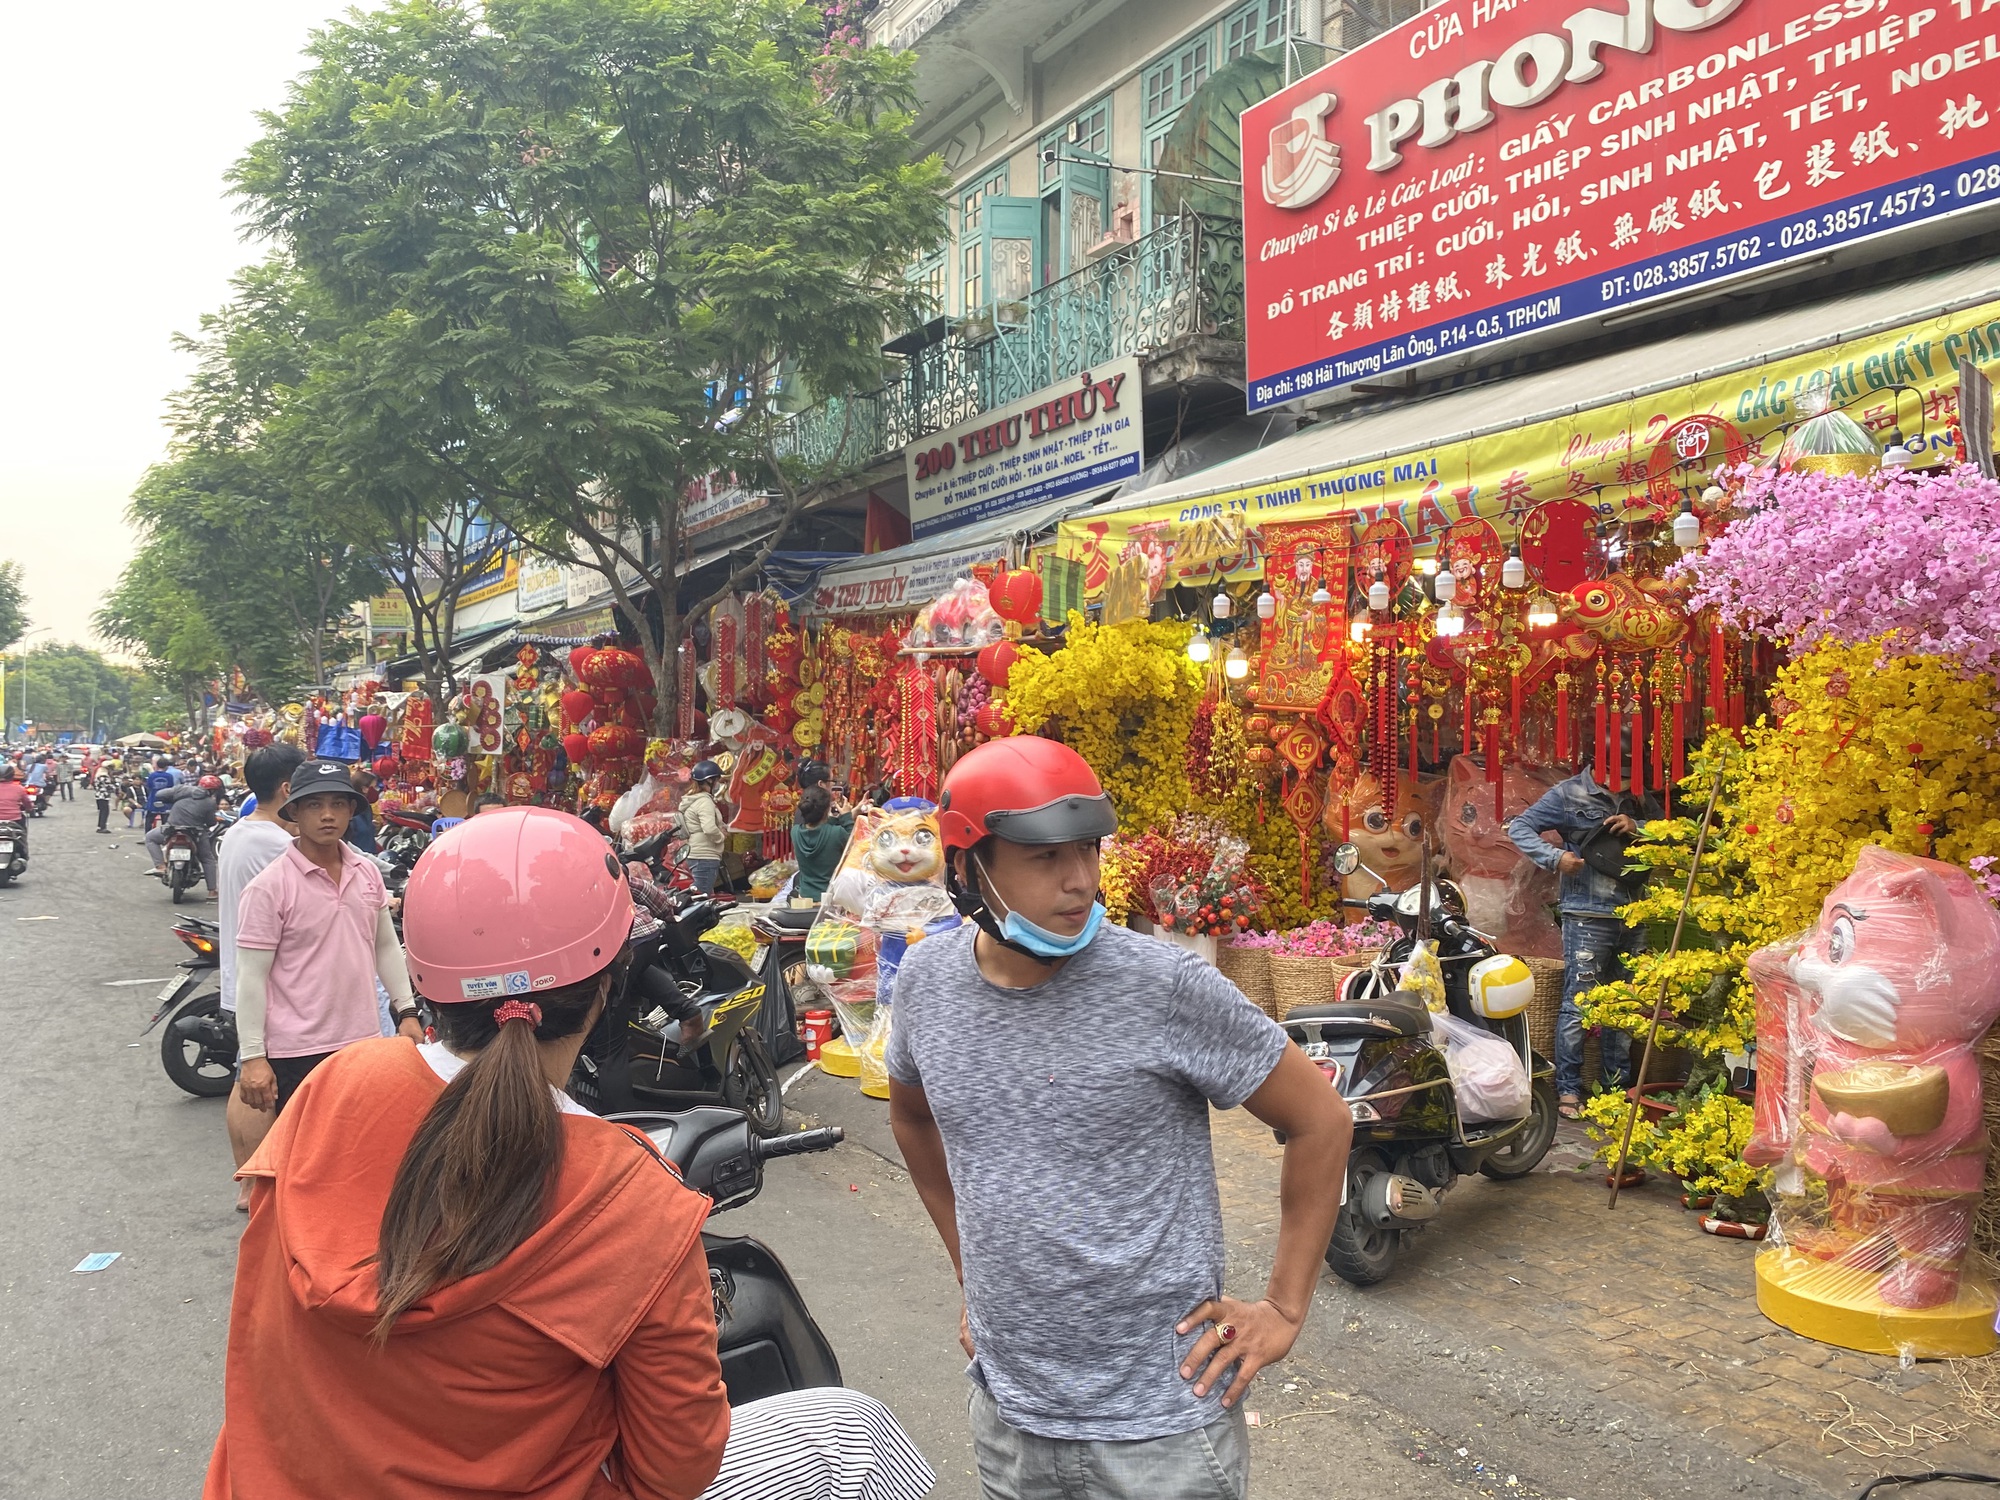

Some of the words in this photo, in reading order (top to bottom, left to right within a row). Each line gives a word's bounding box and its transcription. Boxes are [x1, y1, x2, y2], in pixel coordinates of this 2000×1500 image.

[1409, 12, 1464, 59] CỬA
[1260, 225, 1318, 262] Chuyên
[1344, 204, 1358, 226] &
[1365, 188, 1386, 218] Lẻ
[1391, 176, 1425, 208] Các
[1500, 114, 1576, 161] GIẤY
[1588, 0, 1889, 125] CARBONLESS,
[1357, 213, 1423, 251] THIỆP
[1431, 182, 1499, 221] CƯỚI,
[1505, 146, 1591, 194] THIỆP
[1600, 111, 1675, 157] SINH
[1688, 67, 1797, 125] NHẬT,
[1807, 8, 1937, 76] THIỆP
[1951, 0, 2000, 20] T
[1267, 288, 1294, 319] ĐỒ
[1299, 268, 1368, 307] TRANG
[1436, 219, 1503, 257] CƯỚI,
[1512, 195, 1570, 230] HỎI,
[1580, 166, 1653, 205] SINH
[1666, 121, 1768, 176] NHẬT,
[1784, 81, 1868, 131] TẾT,
[1892, 34, 2000, 95] NOEL
[1602, 275, 1630, 302] ĐT:
[1633, 236, 1761, 293] 028.3857.5762
[1780, 183, 1935, 250] 028.3857.4573
[1256, 385, 1272, 403] Địa
[1275, 377, 1293, 397] chỉ:
[1295, 374, 1313, 392] 198
[1316, 366, 1333, 386] Hải
[1335, 354, 1380, 382] Thượng
[1383, 345, 1404, 367] Lãn
[1408, 335, 1437, 358] Ông,
[1440, 326, 1467, 348] P.14
[1476, 318, 1504, 339] Q.5,
[1507, 296, 1561, 330] TP.HCM
[1736, 377, 1786, 423] CÁC
[1864, 333, 1934, 390] GIẤY
[915, 442, 956, 480] 200
[958, 413, 1022, 463] THU
[1025, 371, 1126, 440] THỦY
[1000, 456, 1021, 471] THIỆP
[1023, 449, 1040, 463] SINH
[1095, 423, 1112, 438] TÂN
[1115, 417, 1130, 431] GIA
[1561, 430, 1636, 467] Chuyên
[955, 488, 977, 502] TRANG
[978, 484, 989, 496] TRÍ
[1028, 463, 1042, 478] TÂN
[1045, 459, 1059, 472] GIA
[1064, 450, 1085, 466] NOEL
[1179, 503, 1222, 522] CÔNG
[1228, 498, 1248, 512] TY
[1257, 487, 1301, 510] TNHH
[1307, 471, 1386, 500] THƯƠNG
[1393, 457, 1437, 484] MẠI
[379, 601, 398, 609] 214
[836, 582, 867, 608] THU
[865, 566, 909, 605] THỦY
[1624, 607, 1657, 637] 福
[534, 976, 554, 987] JOKO
